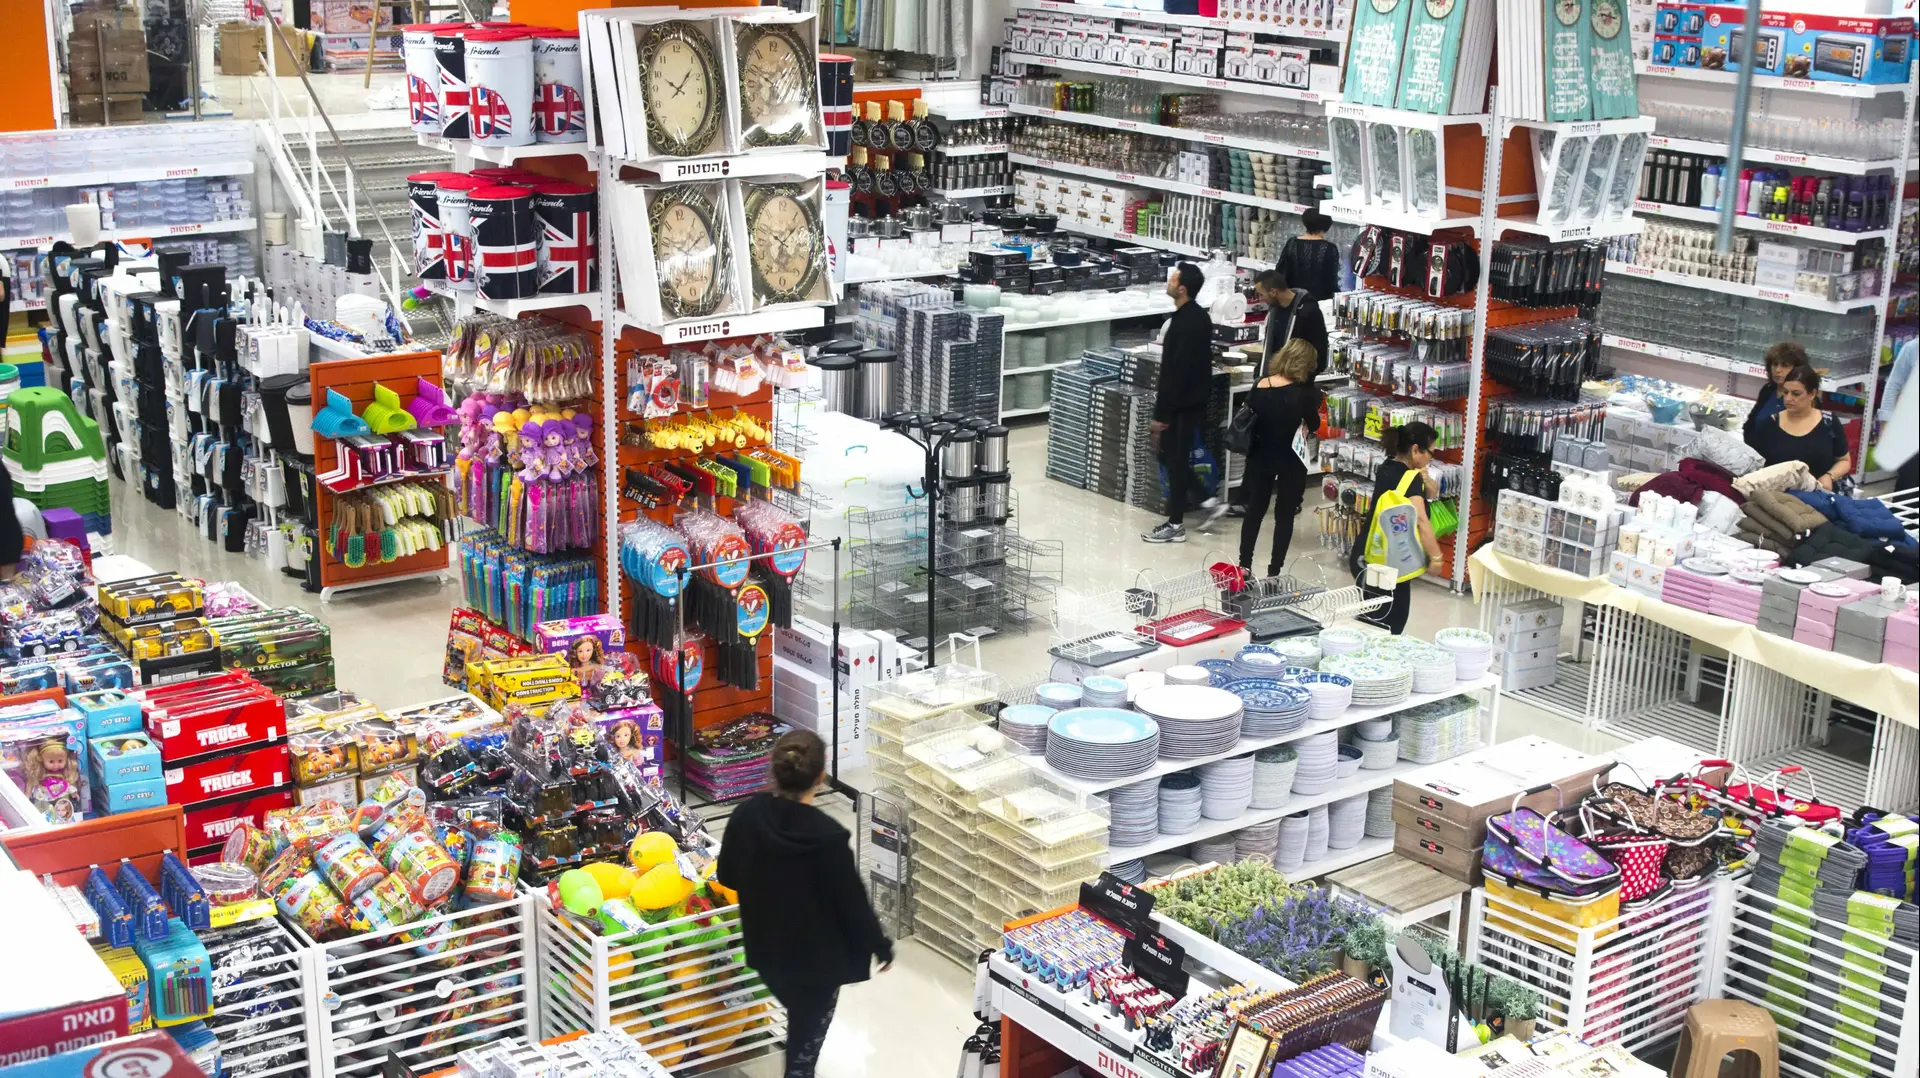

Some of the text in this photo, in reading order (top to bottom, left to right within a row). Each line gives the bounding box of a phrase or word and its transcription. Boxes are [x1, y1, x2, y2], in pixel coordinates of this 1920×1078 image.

[540, 43, 579, 54] friends
[678, 162, 720, 177] הסטוק
[679, 322, 721, 338] הסטוק
[257, 660, 298, 672] TRACTOR
[277, 691, 303, 700] CTOR
[197, 723, 249, 747] TRUCK
[200, 770, 253, 794] TRUCK
[63, 1006, 116, 1032] מאיה
[1135, 1049, 1178, 1077] ARCOSTEEL
